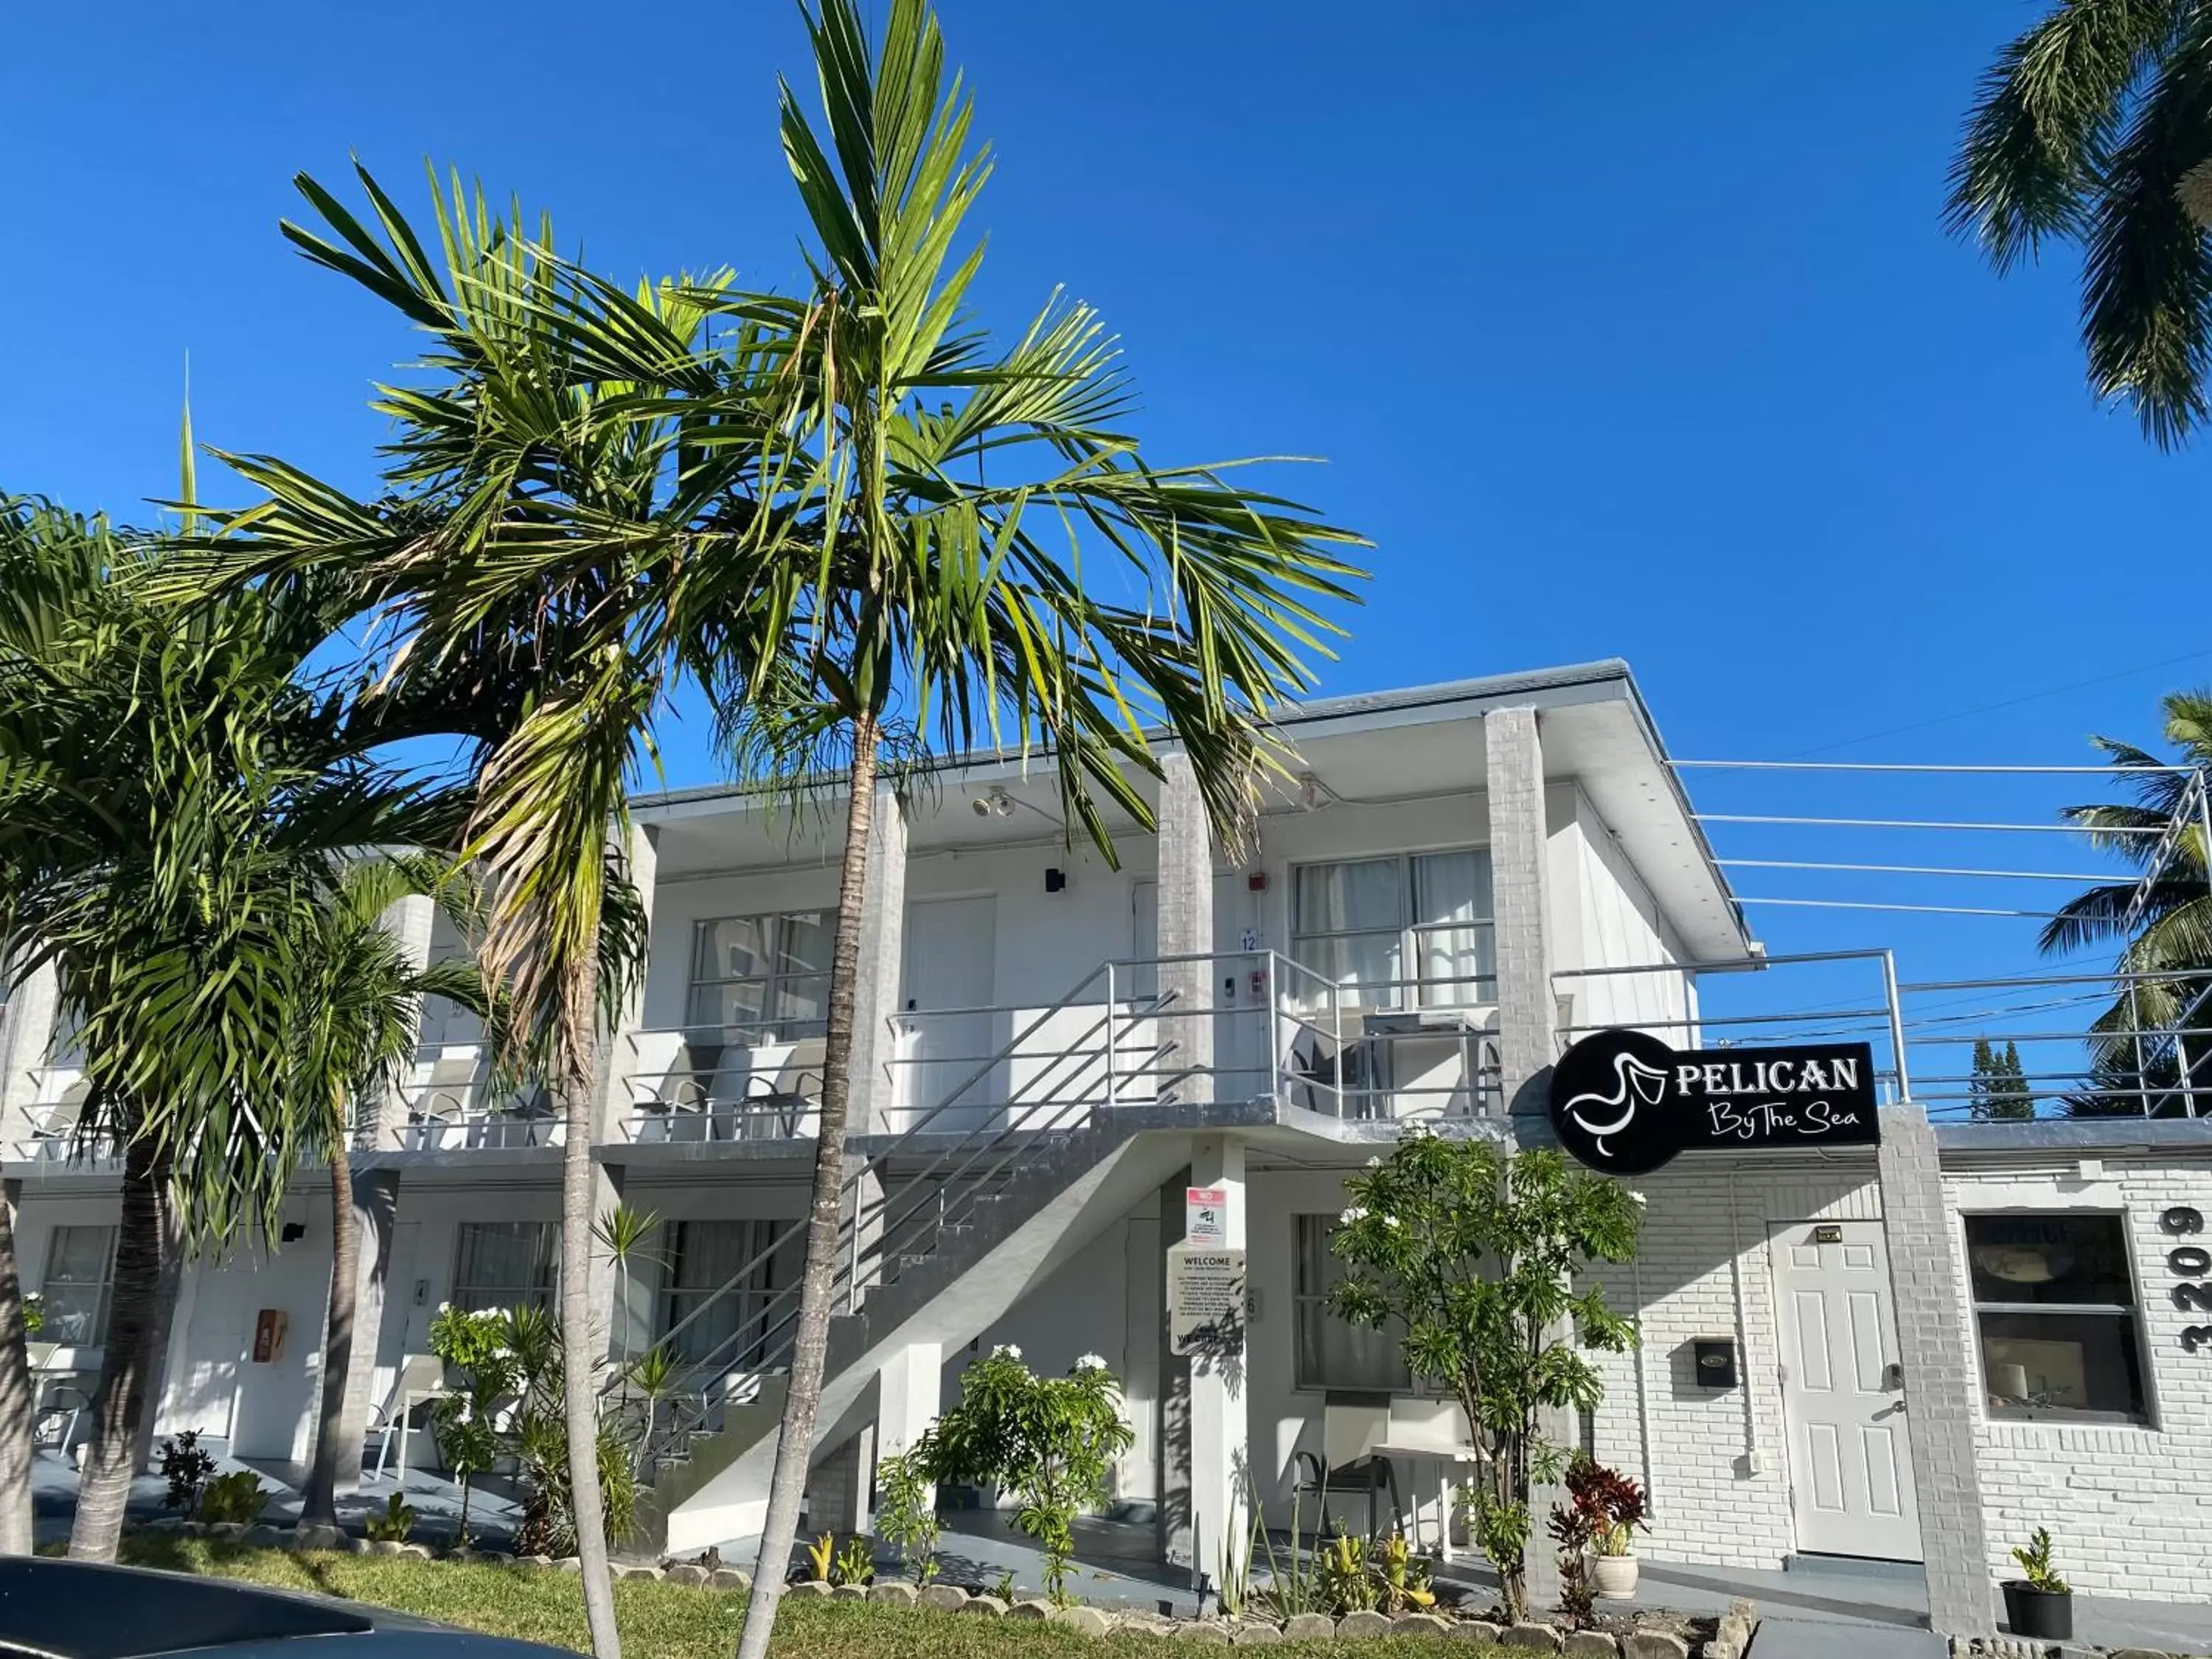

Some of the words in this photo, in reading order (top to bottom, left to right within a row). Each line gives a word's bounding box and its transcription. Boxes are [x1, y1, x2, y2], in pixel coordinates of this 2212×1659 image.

[1242, 936, 1256, 951] 12
[1675, 1058, 1859, 1096] PELICAN
[1707, 1101, 1756, 1139] By
[1747, 1102, 1798, 1136] The
[1797, 1101, 1860, 1134] Sea
[1183, 1257, 1231, 1266] WELCOME
[1247, 1297, 1255, 1313] 6
